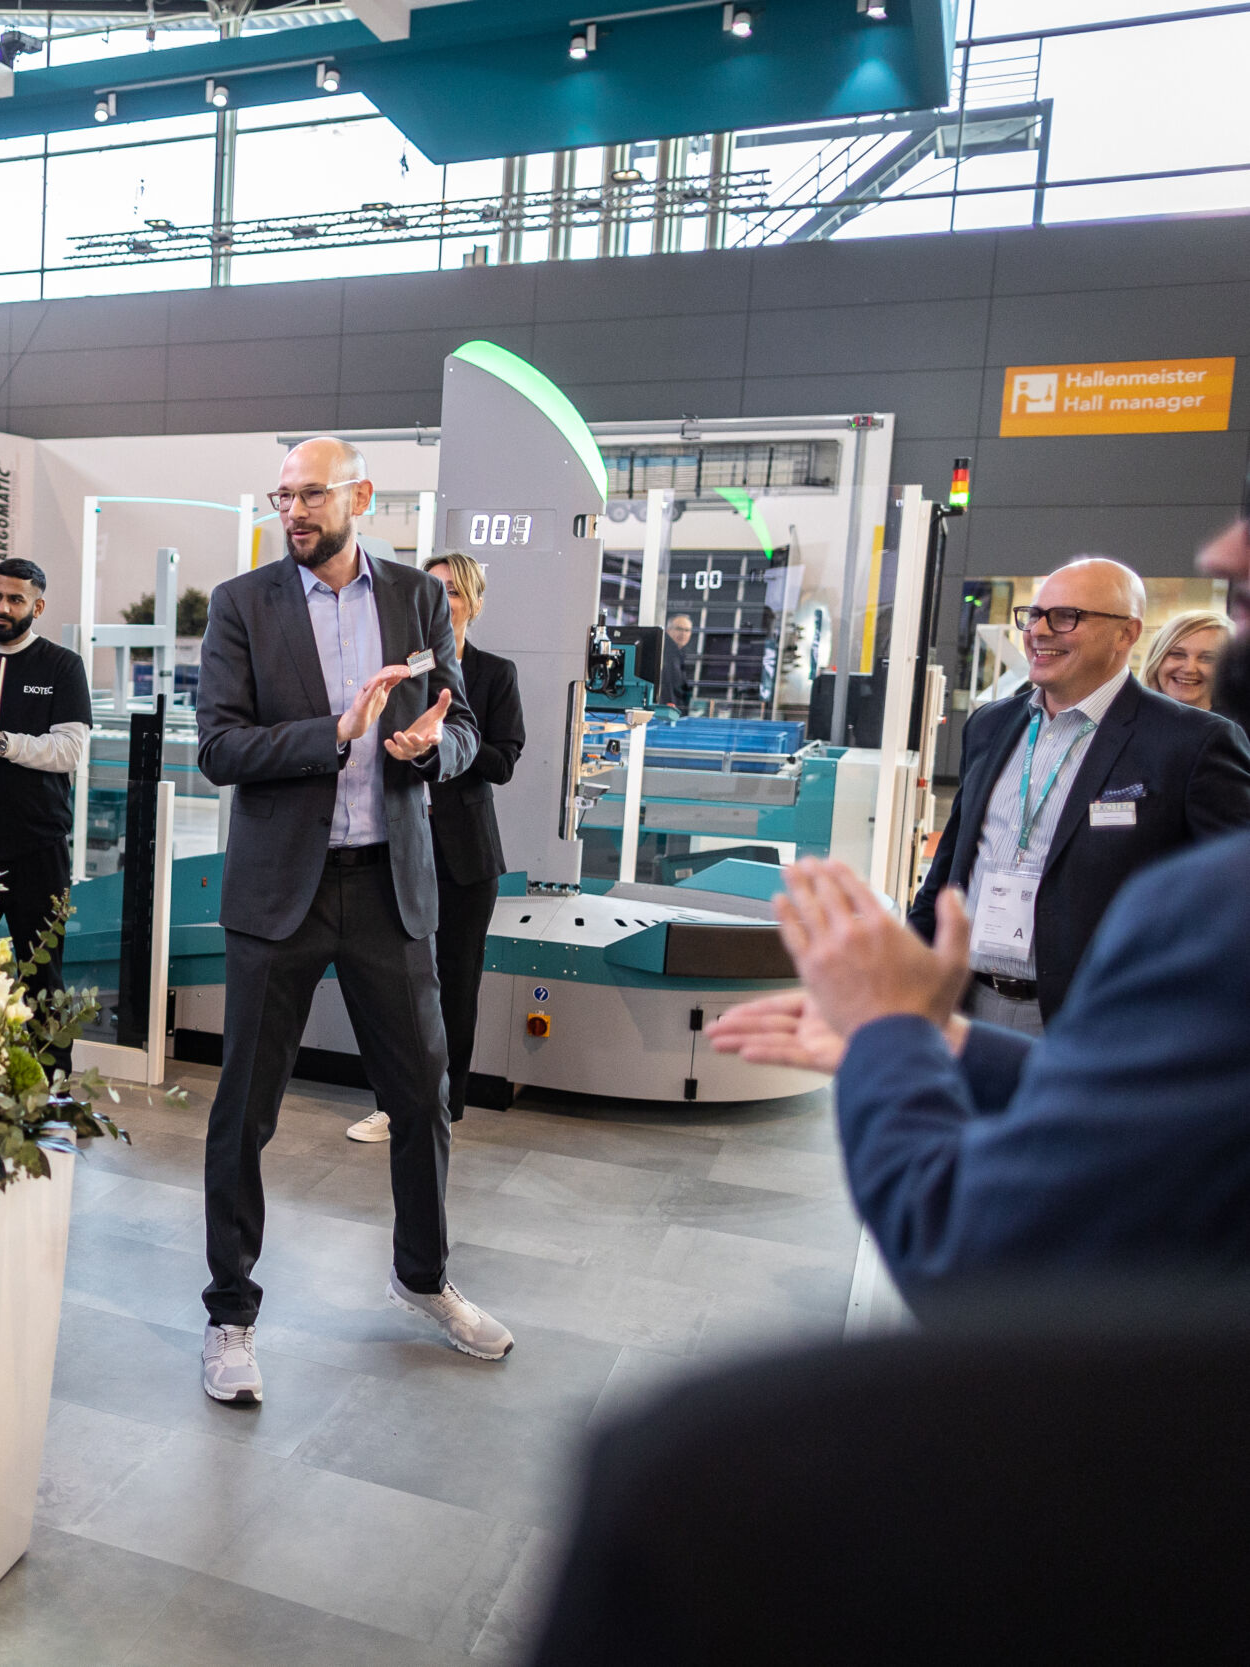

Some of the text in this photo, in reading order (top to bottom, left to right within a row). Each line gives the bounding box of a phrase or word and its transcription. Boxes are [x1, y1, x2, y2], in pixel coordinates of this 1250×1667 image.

[1065, 369, 1208, 389] Hallenmeister
[1063, 394, 1206, 413] Hall manager
[23, 685, 54, 695] EXOTEC
[1013, 927, 1024, 940] A
